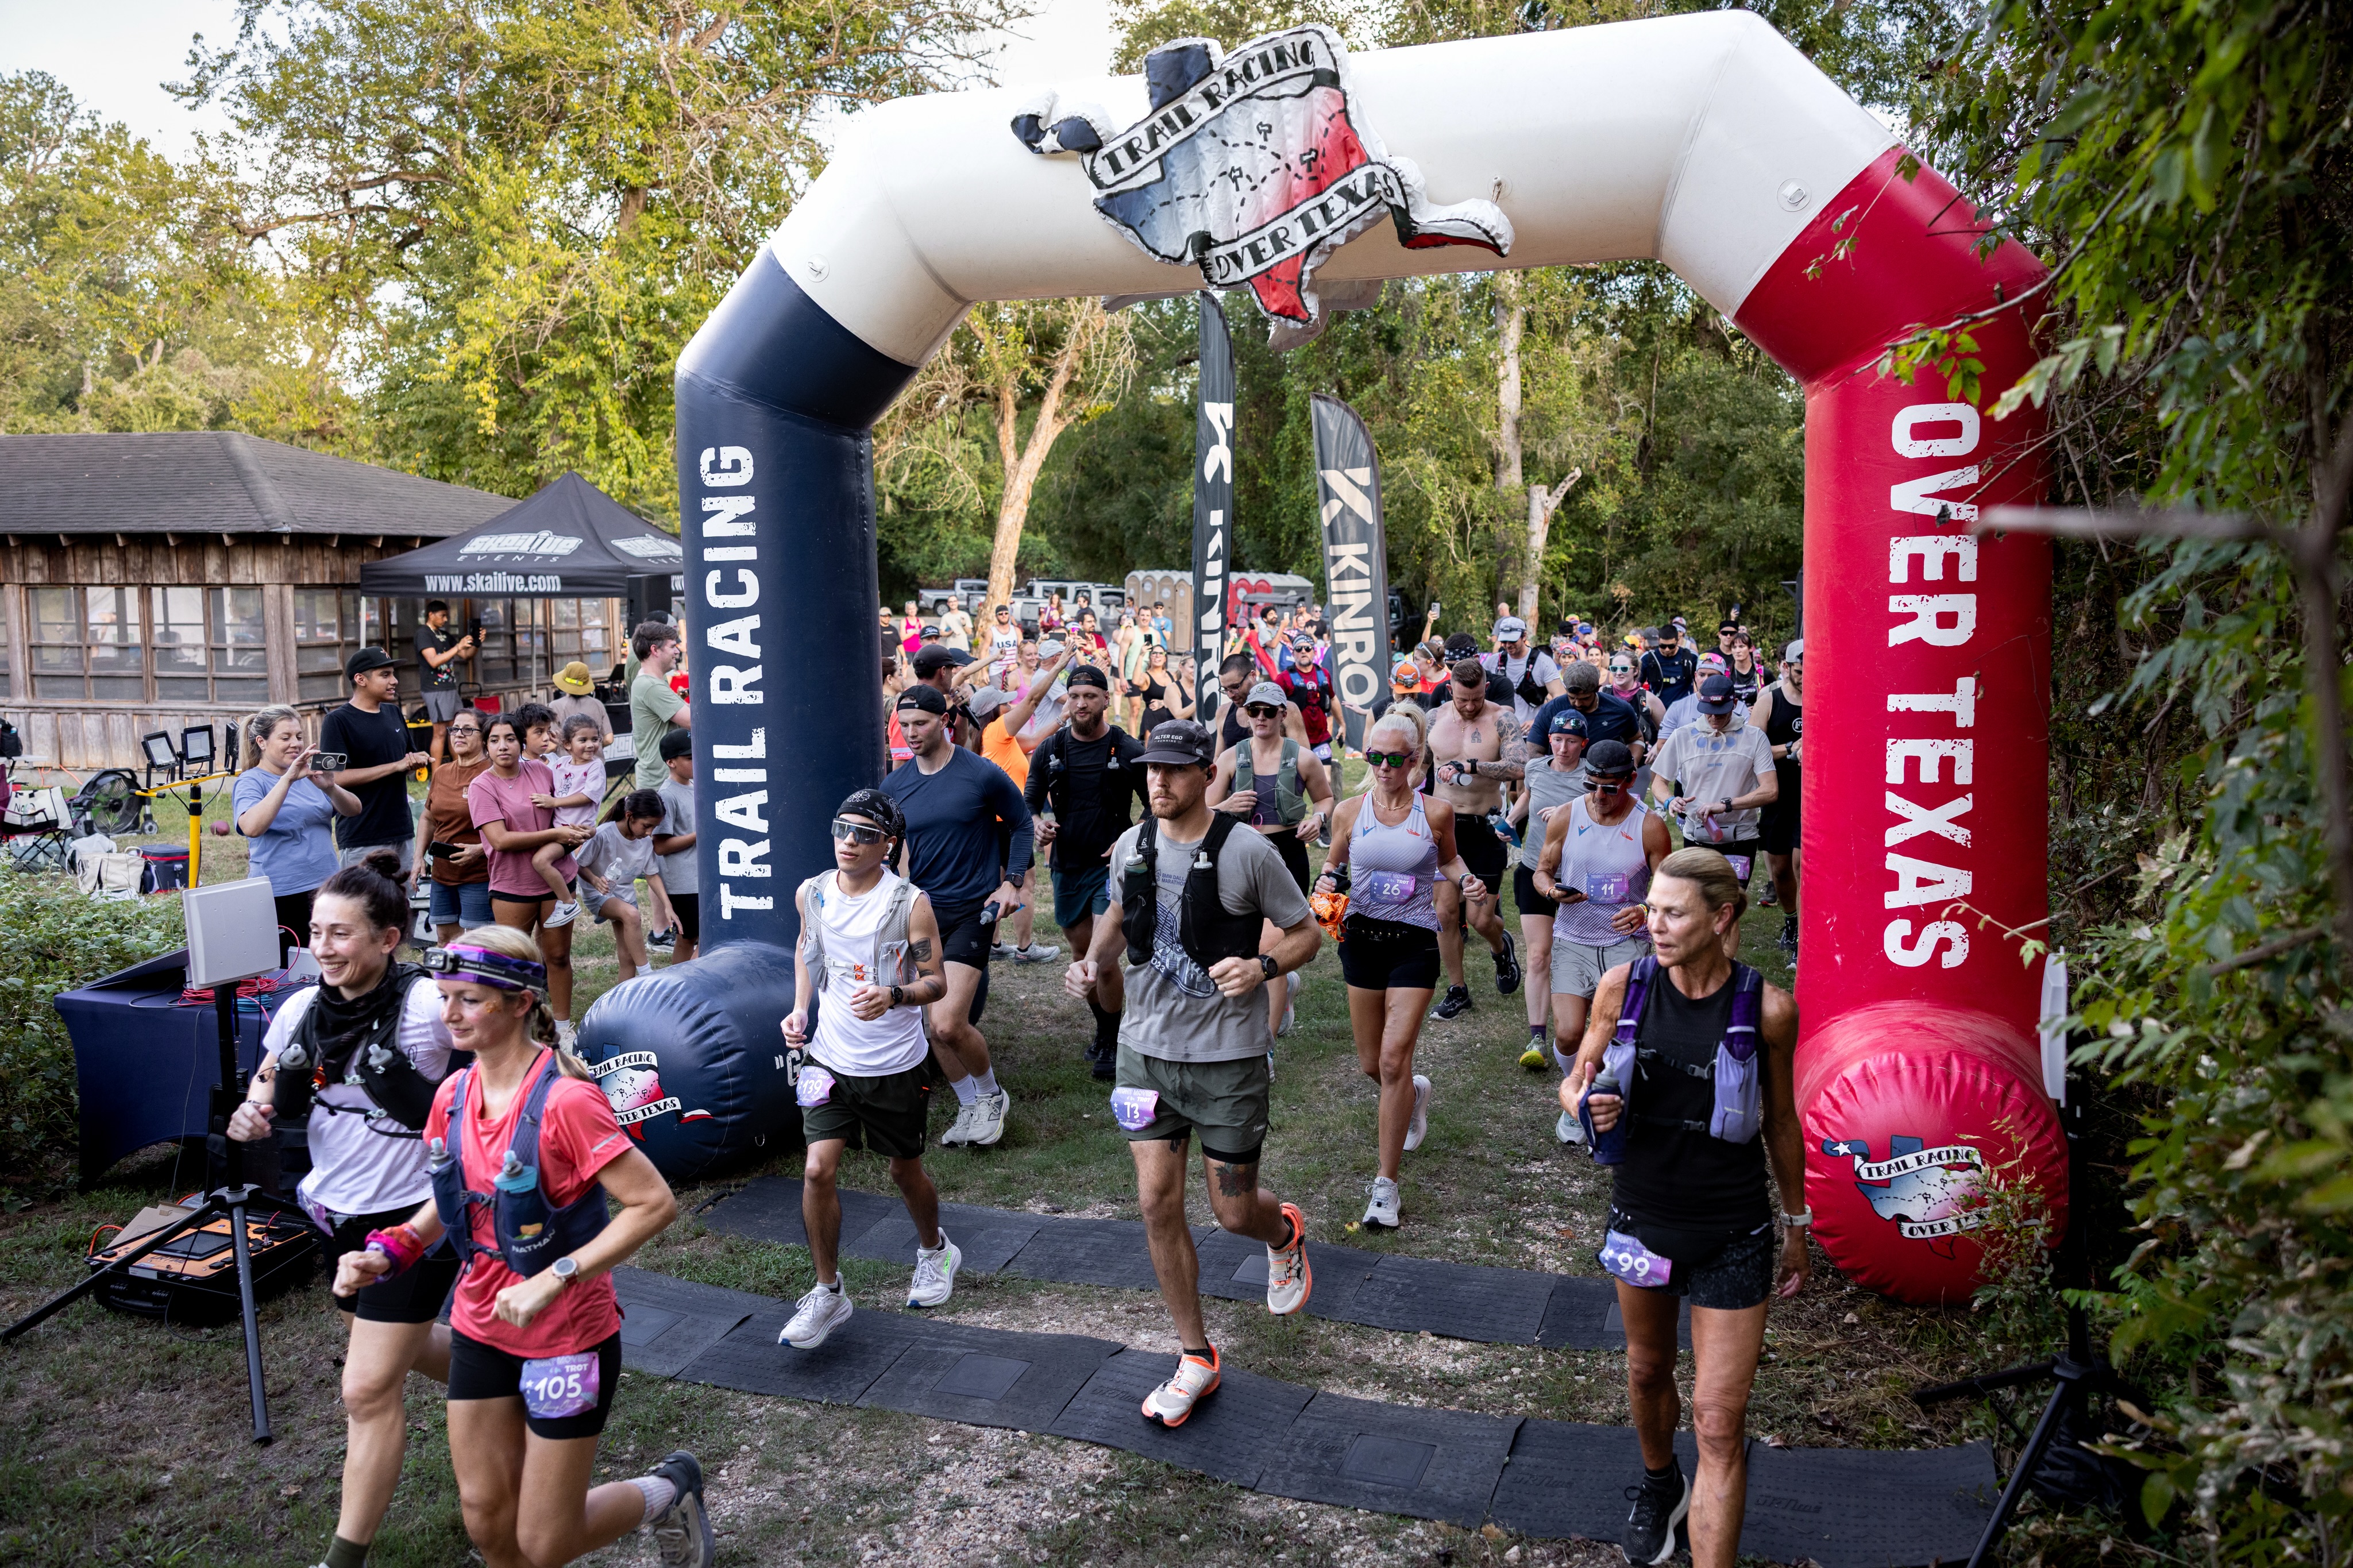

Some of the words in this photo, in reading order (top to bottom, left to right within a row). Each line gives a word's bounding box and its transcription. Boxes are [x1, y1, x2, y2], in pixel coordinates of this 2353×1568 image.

[1102, 106, 1202, 176] TRAIL
[1199, 39, 1316, 111] RACING
[1216, 225, 1297, 280] OVER
[1294, 172, 1395, 237] TEXAS
[1888, 402, 1980, 648] OVER
[425, 571, 562, 592] www.skailive.com
[699, 445, 764, 705] RACING
[1329, 543, 1379, 709] KINRO
[997, 640, 1017, 649] USA
[712, 727, 774, 920] TRAIL
[1883, 676, 1976, 970] TEXAS
[1382, 883, 1401, 896] 26
[1601, 883, 1614, 895] 11
[480, 963, 506, 975] Diamond
[614, 1053, 653, 1068] RACING
[803, 1079, 823, 1095] 139
[616, 1111, 641, 1123] OVER
[639, 1099, 677, 1118] TEXAS
[1124, 1102, 1140, 1119] 73
[1864, 1159, 1914, 1178] TRAIL
[1914, 1149, 1975, 1167] RACING
[1907, 1221, 1952, 1236] OVER
[511, 1229, 556, 1253] NATHAN
[942, 1249, 952, 1276] HOKA
[1617, 1252, 1650, 1277] 99
[556, 1353, 589, 1365] MOVES
[565, 1363, 589, 1373] TROT
[534, 1373, 583, 1401] 105
